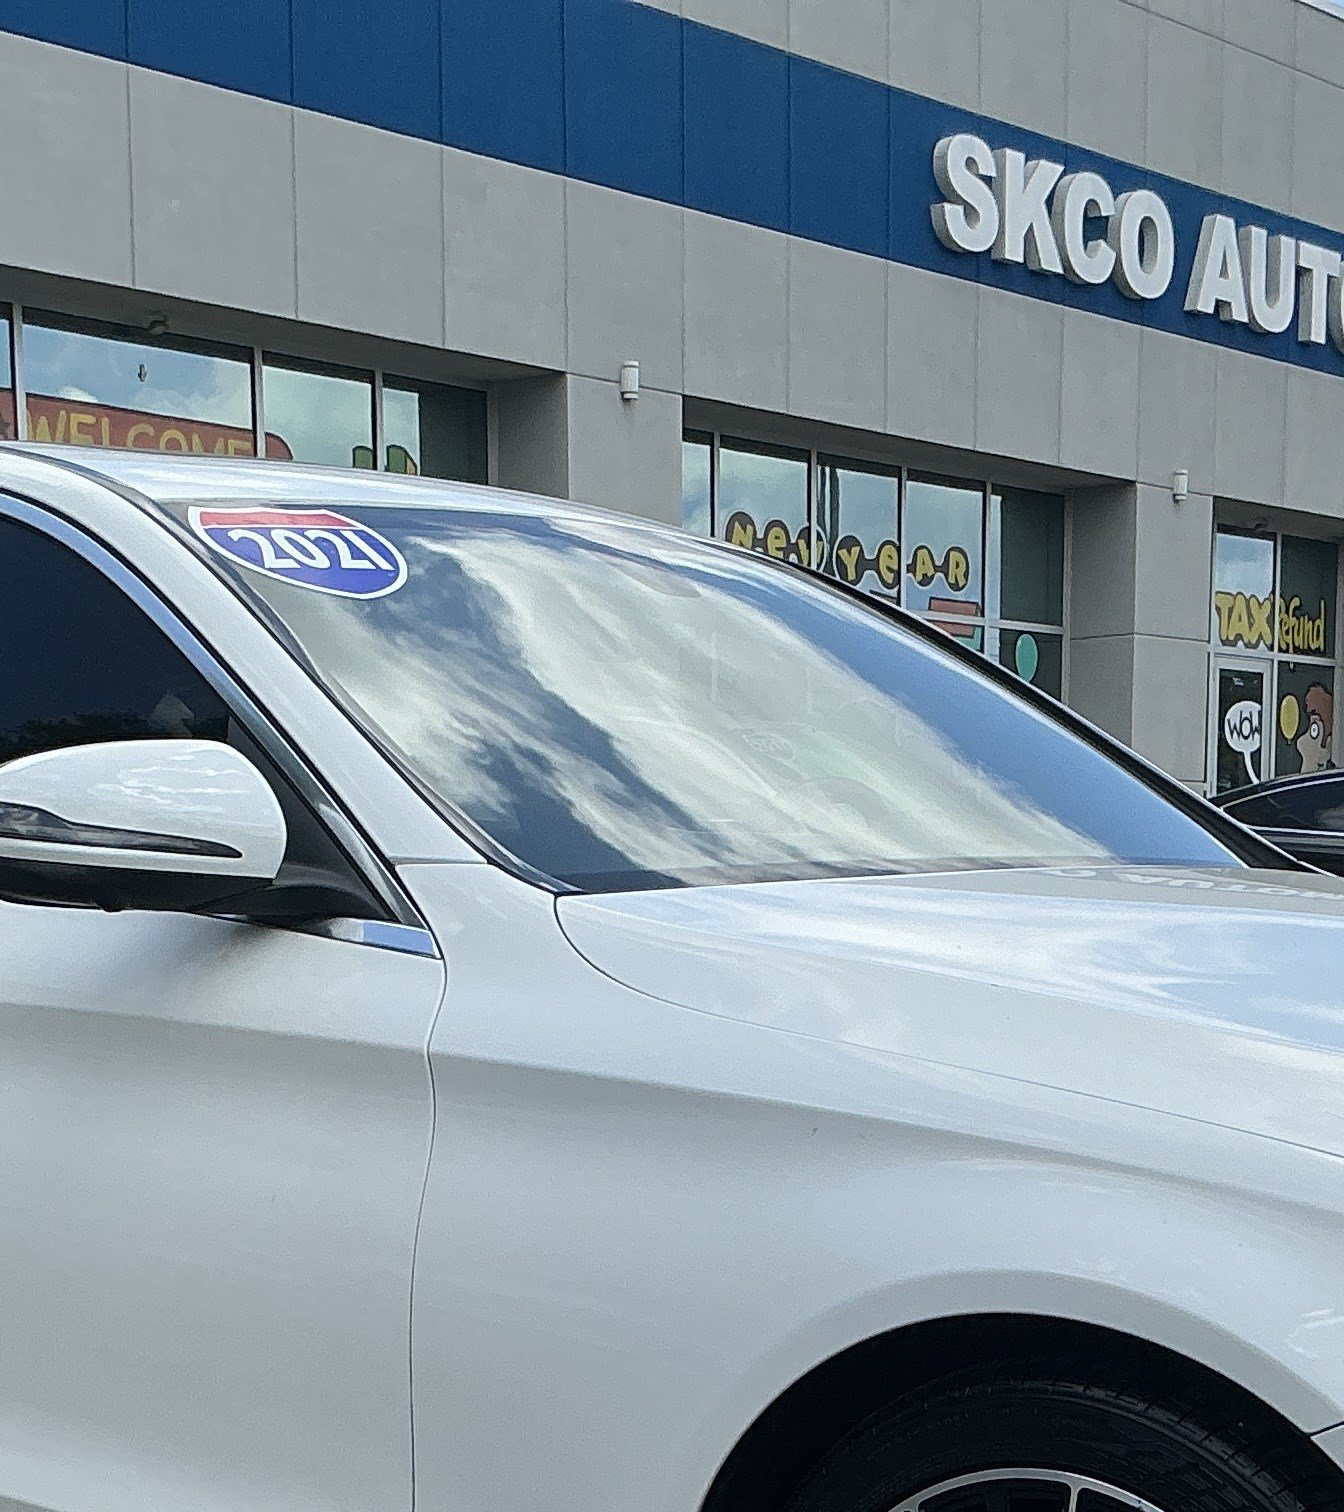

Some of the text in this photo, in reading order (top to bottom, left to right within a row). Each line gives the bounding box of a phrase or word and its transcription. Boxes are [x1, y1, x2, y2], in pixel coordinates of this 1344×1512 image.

[931, 133, 1174, 300] SKCO
[227, 528, 396, 571] 2021
[1214, 591, 1274, 647] TAX
